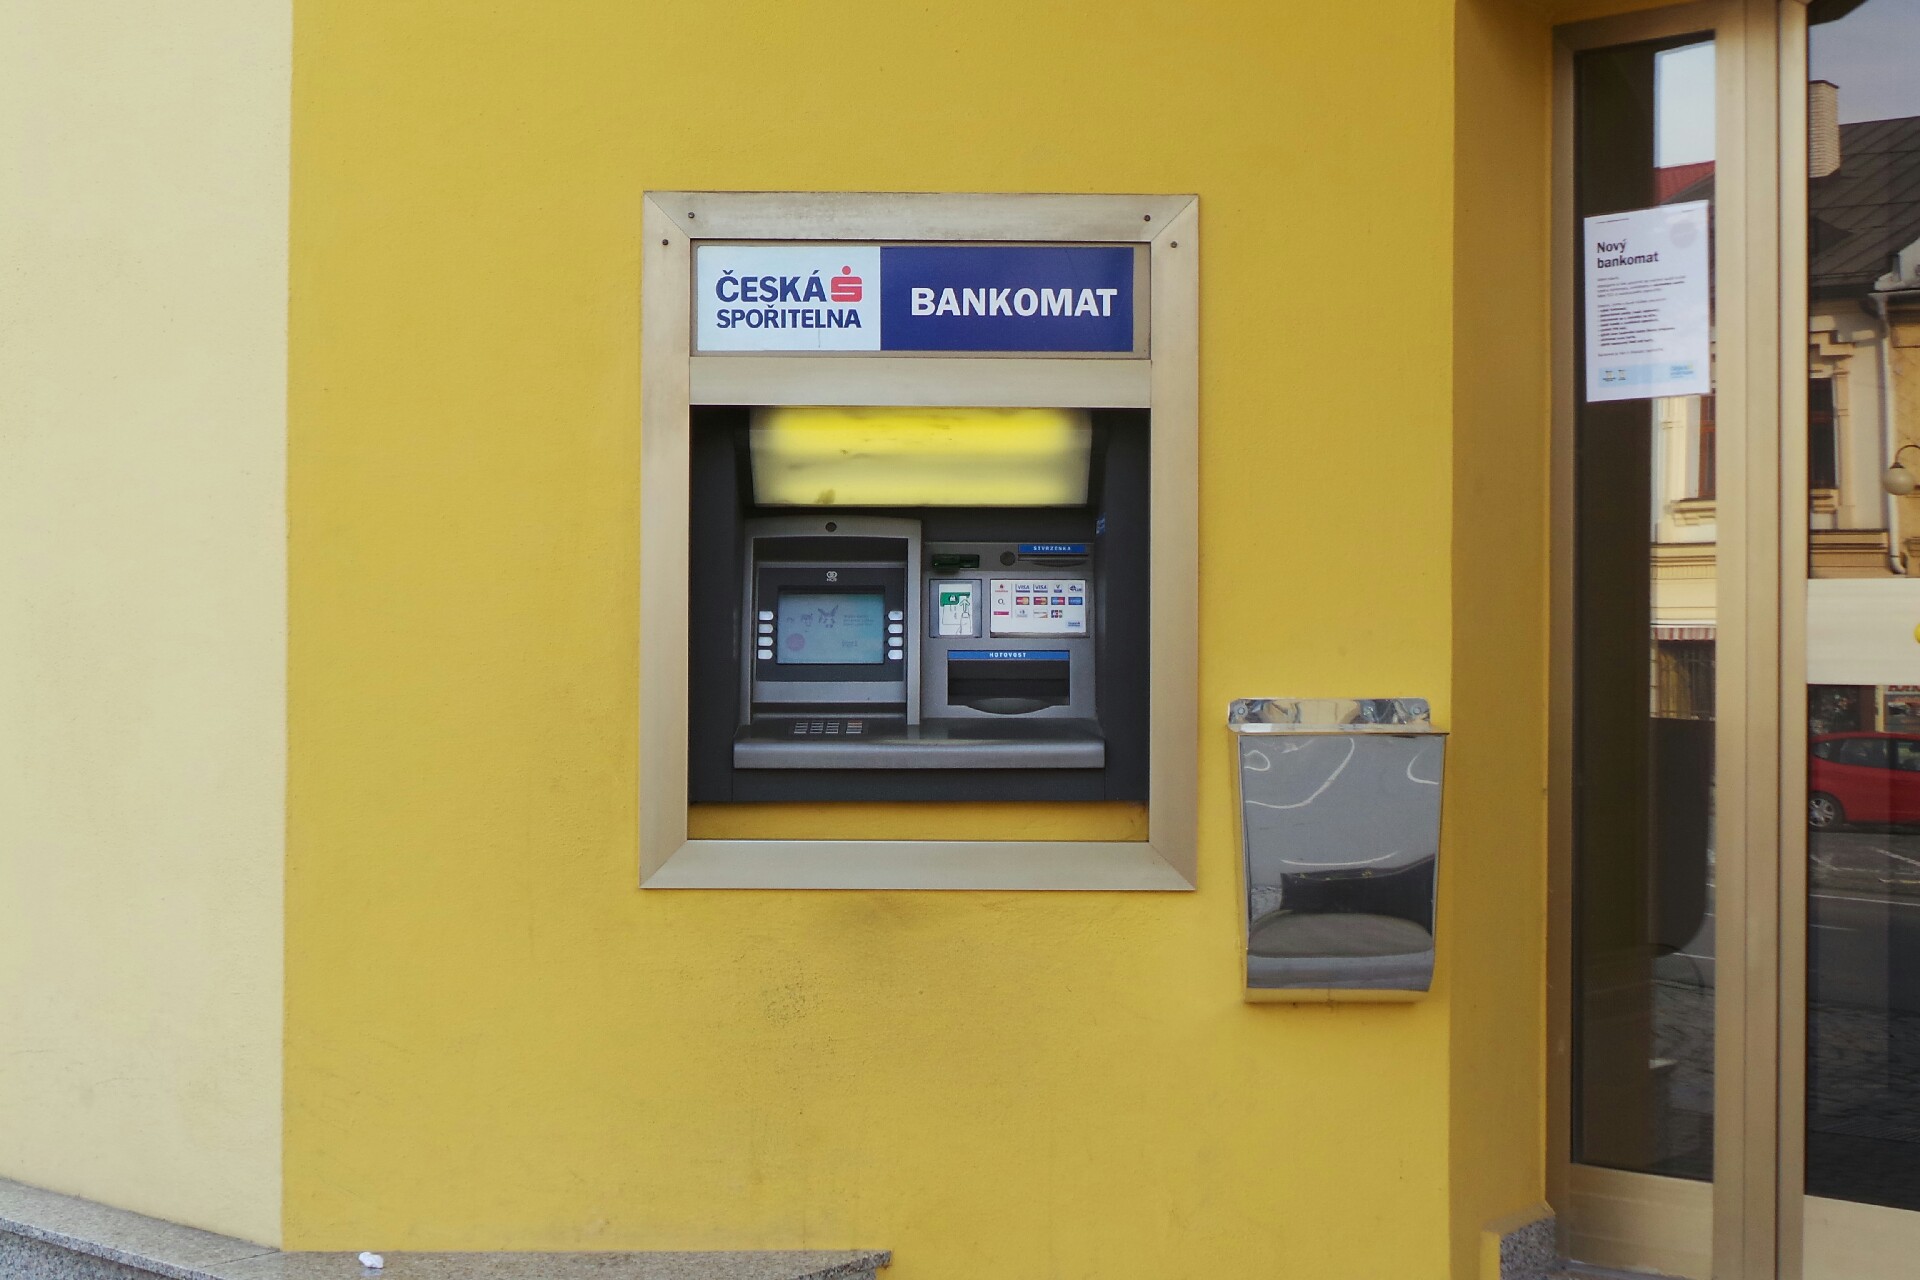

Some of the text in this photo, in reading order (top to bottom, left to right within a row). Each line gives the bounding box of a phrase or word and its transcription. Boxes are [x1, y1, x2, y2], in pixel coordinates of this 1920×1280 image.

[1597, 239, 1627, 254] Nový
[1597, 252, 1660, 269] bankomat
[715, 270, 827, 303] ČESKÁ
[910, 287, 1118, 317] BANKOMAT
[715, 304, 862, 329] SPOŘITELNA
